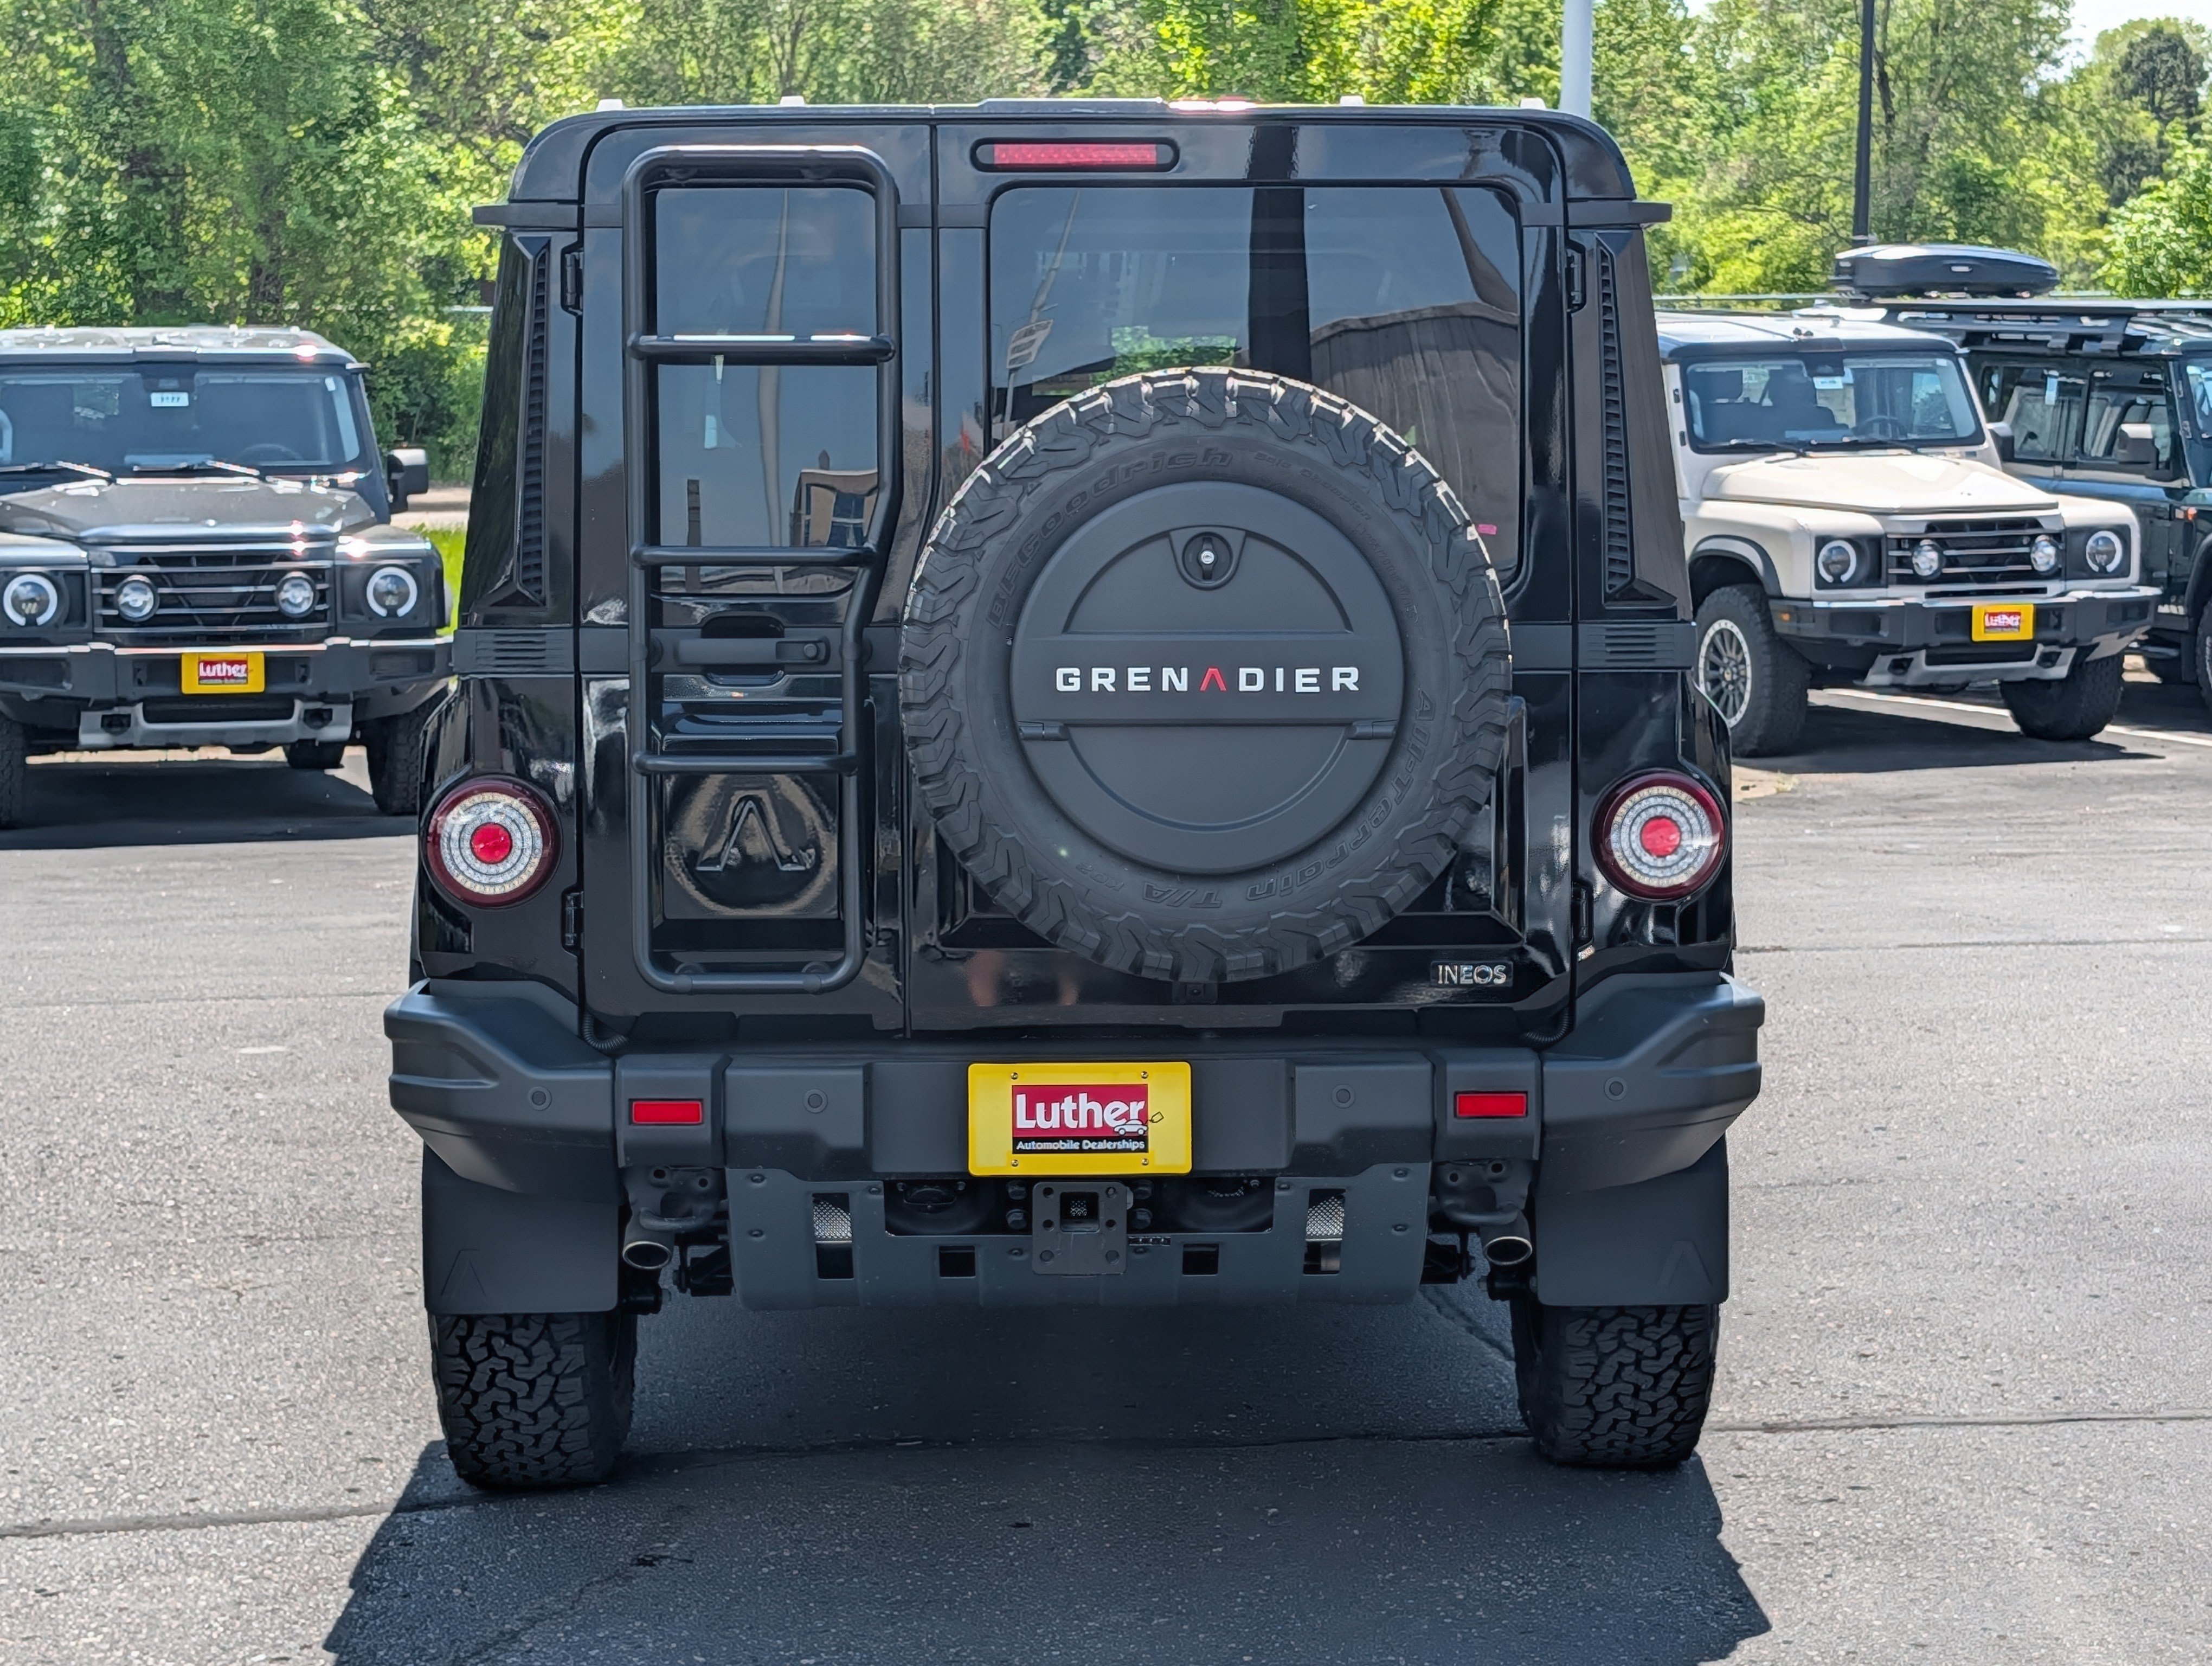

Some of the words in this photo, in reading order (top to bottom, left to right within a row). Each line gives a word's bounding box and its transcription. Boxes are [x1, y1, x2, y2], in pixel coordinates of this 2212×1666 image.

[1300, 467, 1372, 521] Champion
[986, 447, 1233, 626] BFGoodrich
[199, 662, 247, 677] Luther
[1055, 667, 1359, 693] GRENADIER
[1438, 964, 1507, 984] INEOS
[1016, 1093, 1146, 1129] Luther
[1016, 1139, 1080, 1150] Automobile
[1082, 1139, 1145, 1151] Dealerships
